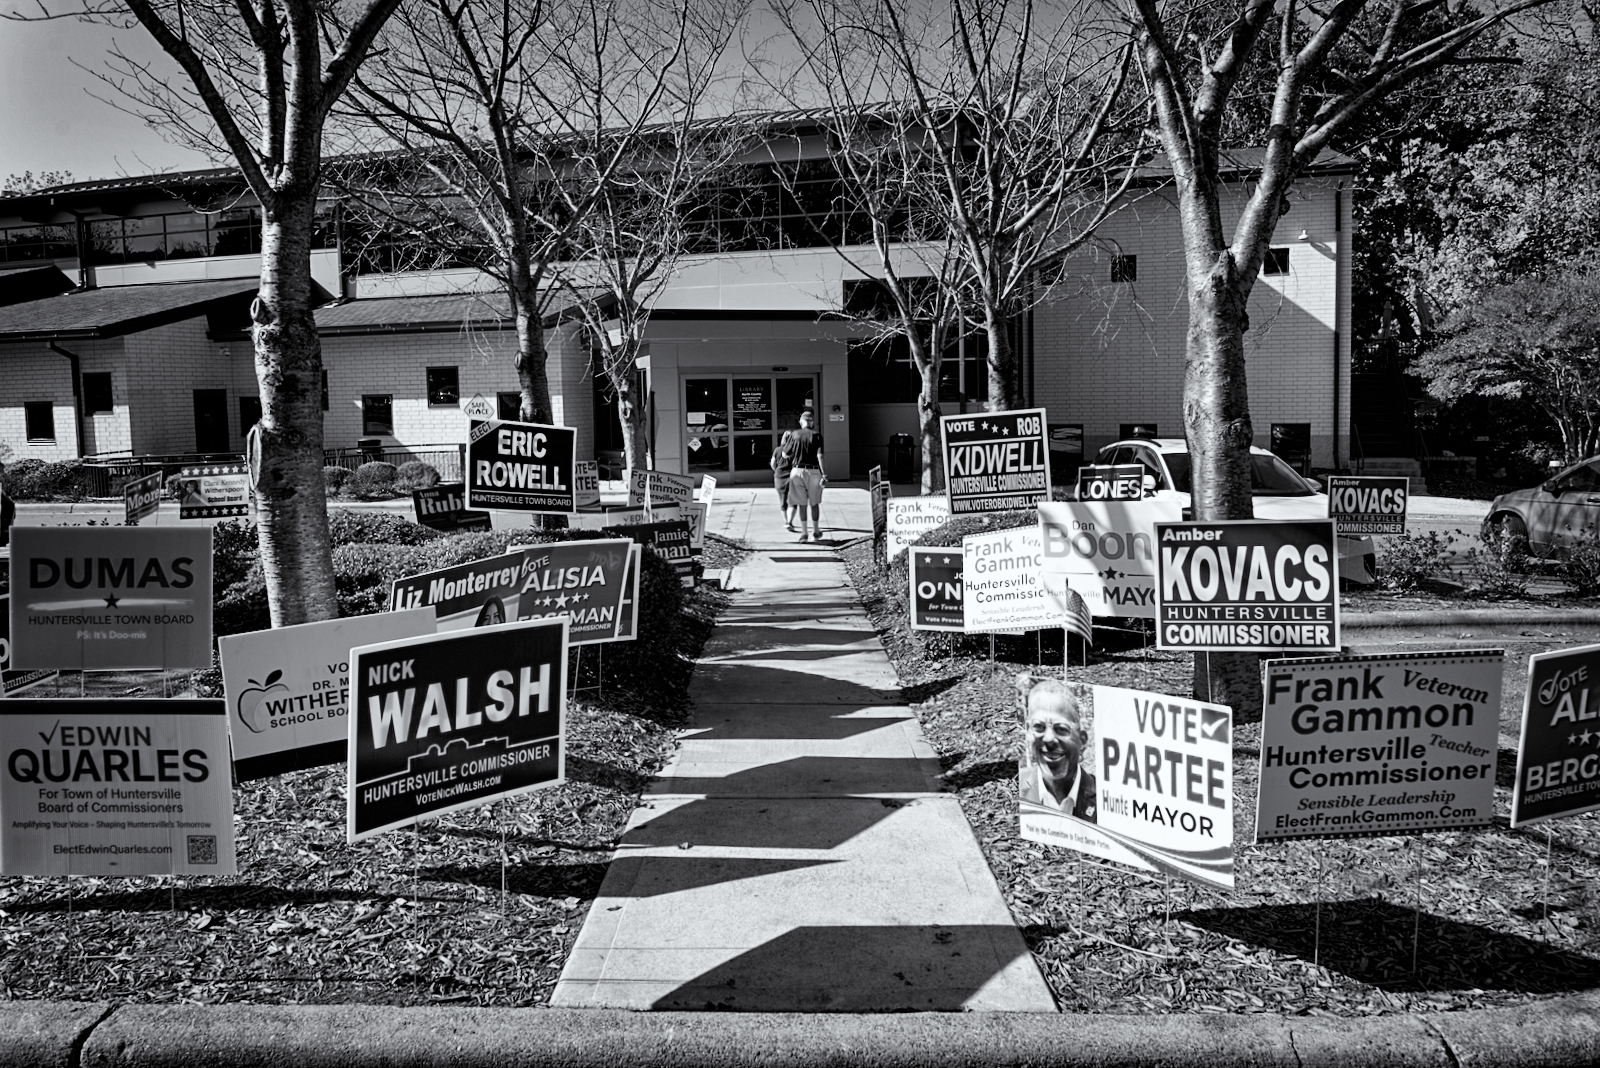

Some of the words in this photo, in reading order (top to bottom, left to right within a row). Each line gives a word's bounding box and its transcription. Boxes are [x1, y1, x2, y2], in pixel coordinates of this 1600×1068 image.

[470, 422, 492, 442] ELECT
[946, 420, 976, 433] VOTE
[1017, 417, 1040, 436] ROB
[498, 429, 548, 458] ERIC
[950, 441, 1045, 477] KIDWELL
[476, 460, 566, 491] ROWELL
[632, 470, 662, 484] Frank
[667, 477, 690, 490] Veteran
[951, 475, 997, 494] HUNTERSVILLE
[998, 472, 1046, 491] COMMISSIONER
[127, 488, 160, 512] Moore
[472, 494, 524, 504] HUNTERSVILLE
[526, 497, 546, 505] TOWN
[548, 498, 572, 506] BOARD
[1082, 480, 1141, 499] JONES
[889, 502, 922, 513] Frank
[953, 495, 1047, 512] WWW.VOTEROBKIDWELL.COM
[1331, 488, 1404, 514] KOVACS
[654, 528, 688, 544] Jamie
[1072, 520, 1095, 531] Dan
[1162, 528, 1224, 542] Amber
[1337, 524, 1402, 533] OMMISSIONER
[656, 545, 690, 560] man
[964, 537, 1013, 558] Frank
[29, 557, 194, 589] DUMAS
[521, 566, 606, 594] ALISIA
[966, 574, 1036, 592] Huntersville
[1162, 544, 1330, 602] KOVACS
[395, 586, 422, 612] Liz
[428, 565, 521, 605] Monterrey
[28, 615, 112, 625] HUNTERSVILLE
[114, 615, 150, 625] TOWN
[154, 615, 194, 625] BOARD
[1168, 607, 1326, 620] HUNTERSVILLE
[77, 630, 92, 640] PS:
[93, 630, 107, 640] It's
[109, 630, 146, 640] Doo-mis
[1166, 624, 1330, 645] COMMISSIONER
[368, 659, 415, 686] NICK
[312, 681, 334, 691] DR.
[1268, 668, 1385, 704] Frank
[1403, 669, 1489, 704] Veteran
[368, 664, 550, 750] WALSH
[270, 713, 324, 728] SCHOOL
[1134, 698, 1198, 745] VOTE
[1292, 702, 1474, 735] Gammon
[60, 726, 151, 746] EDWIN
[1429, 734, 1490, 758] Teacher
[1266, 736, 1426, 767] Huntersville
[8, 748, 209, 784] QUARLES
[364, 766, 457, 804] HUNTERSVILLE
[461, 744, 550, 777] COMMISSIONER
[1103, 737, 1226, 810] PARTEE
[1289, 760, 1491, 789] Commissioner
[1526, 754, 1600, 792] BERG
[39, 788, 59, 800] For
[62, 788, 93, 800] Town
[96, 788, 108, 800] of
[111, 788, 181, 800] Huntersville
[1298, 796, 1364, 811] Sensible
[1368, 790, 1456, 807] Leadership
[1524, 782, 1584, 805] HUNTERSVILLE
[38, 802, 74, 813] Board
[77, 802, 88, 813] of
[92, 802, 183, 814] Commissioners
[1132, 799, 1214, 838] MAYOR
[1276, 806, 1476, 828] ElectFrankGammon.Com
[12, 820, 51, 830] Amplifying
[52, 820, 68, 828] Your
[70, 820, 89, 828] Voice
[96, 820, 126, 830] Shaping
[127, 820, 174, 829] Huntersville's
[176, 820, 211, 829] Tomorrow
[53, 844, 172, 855] ElectEdwinQuarles.com
